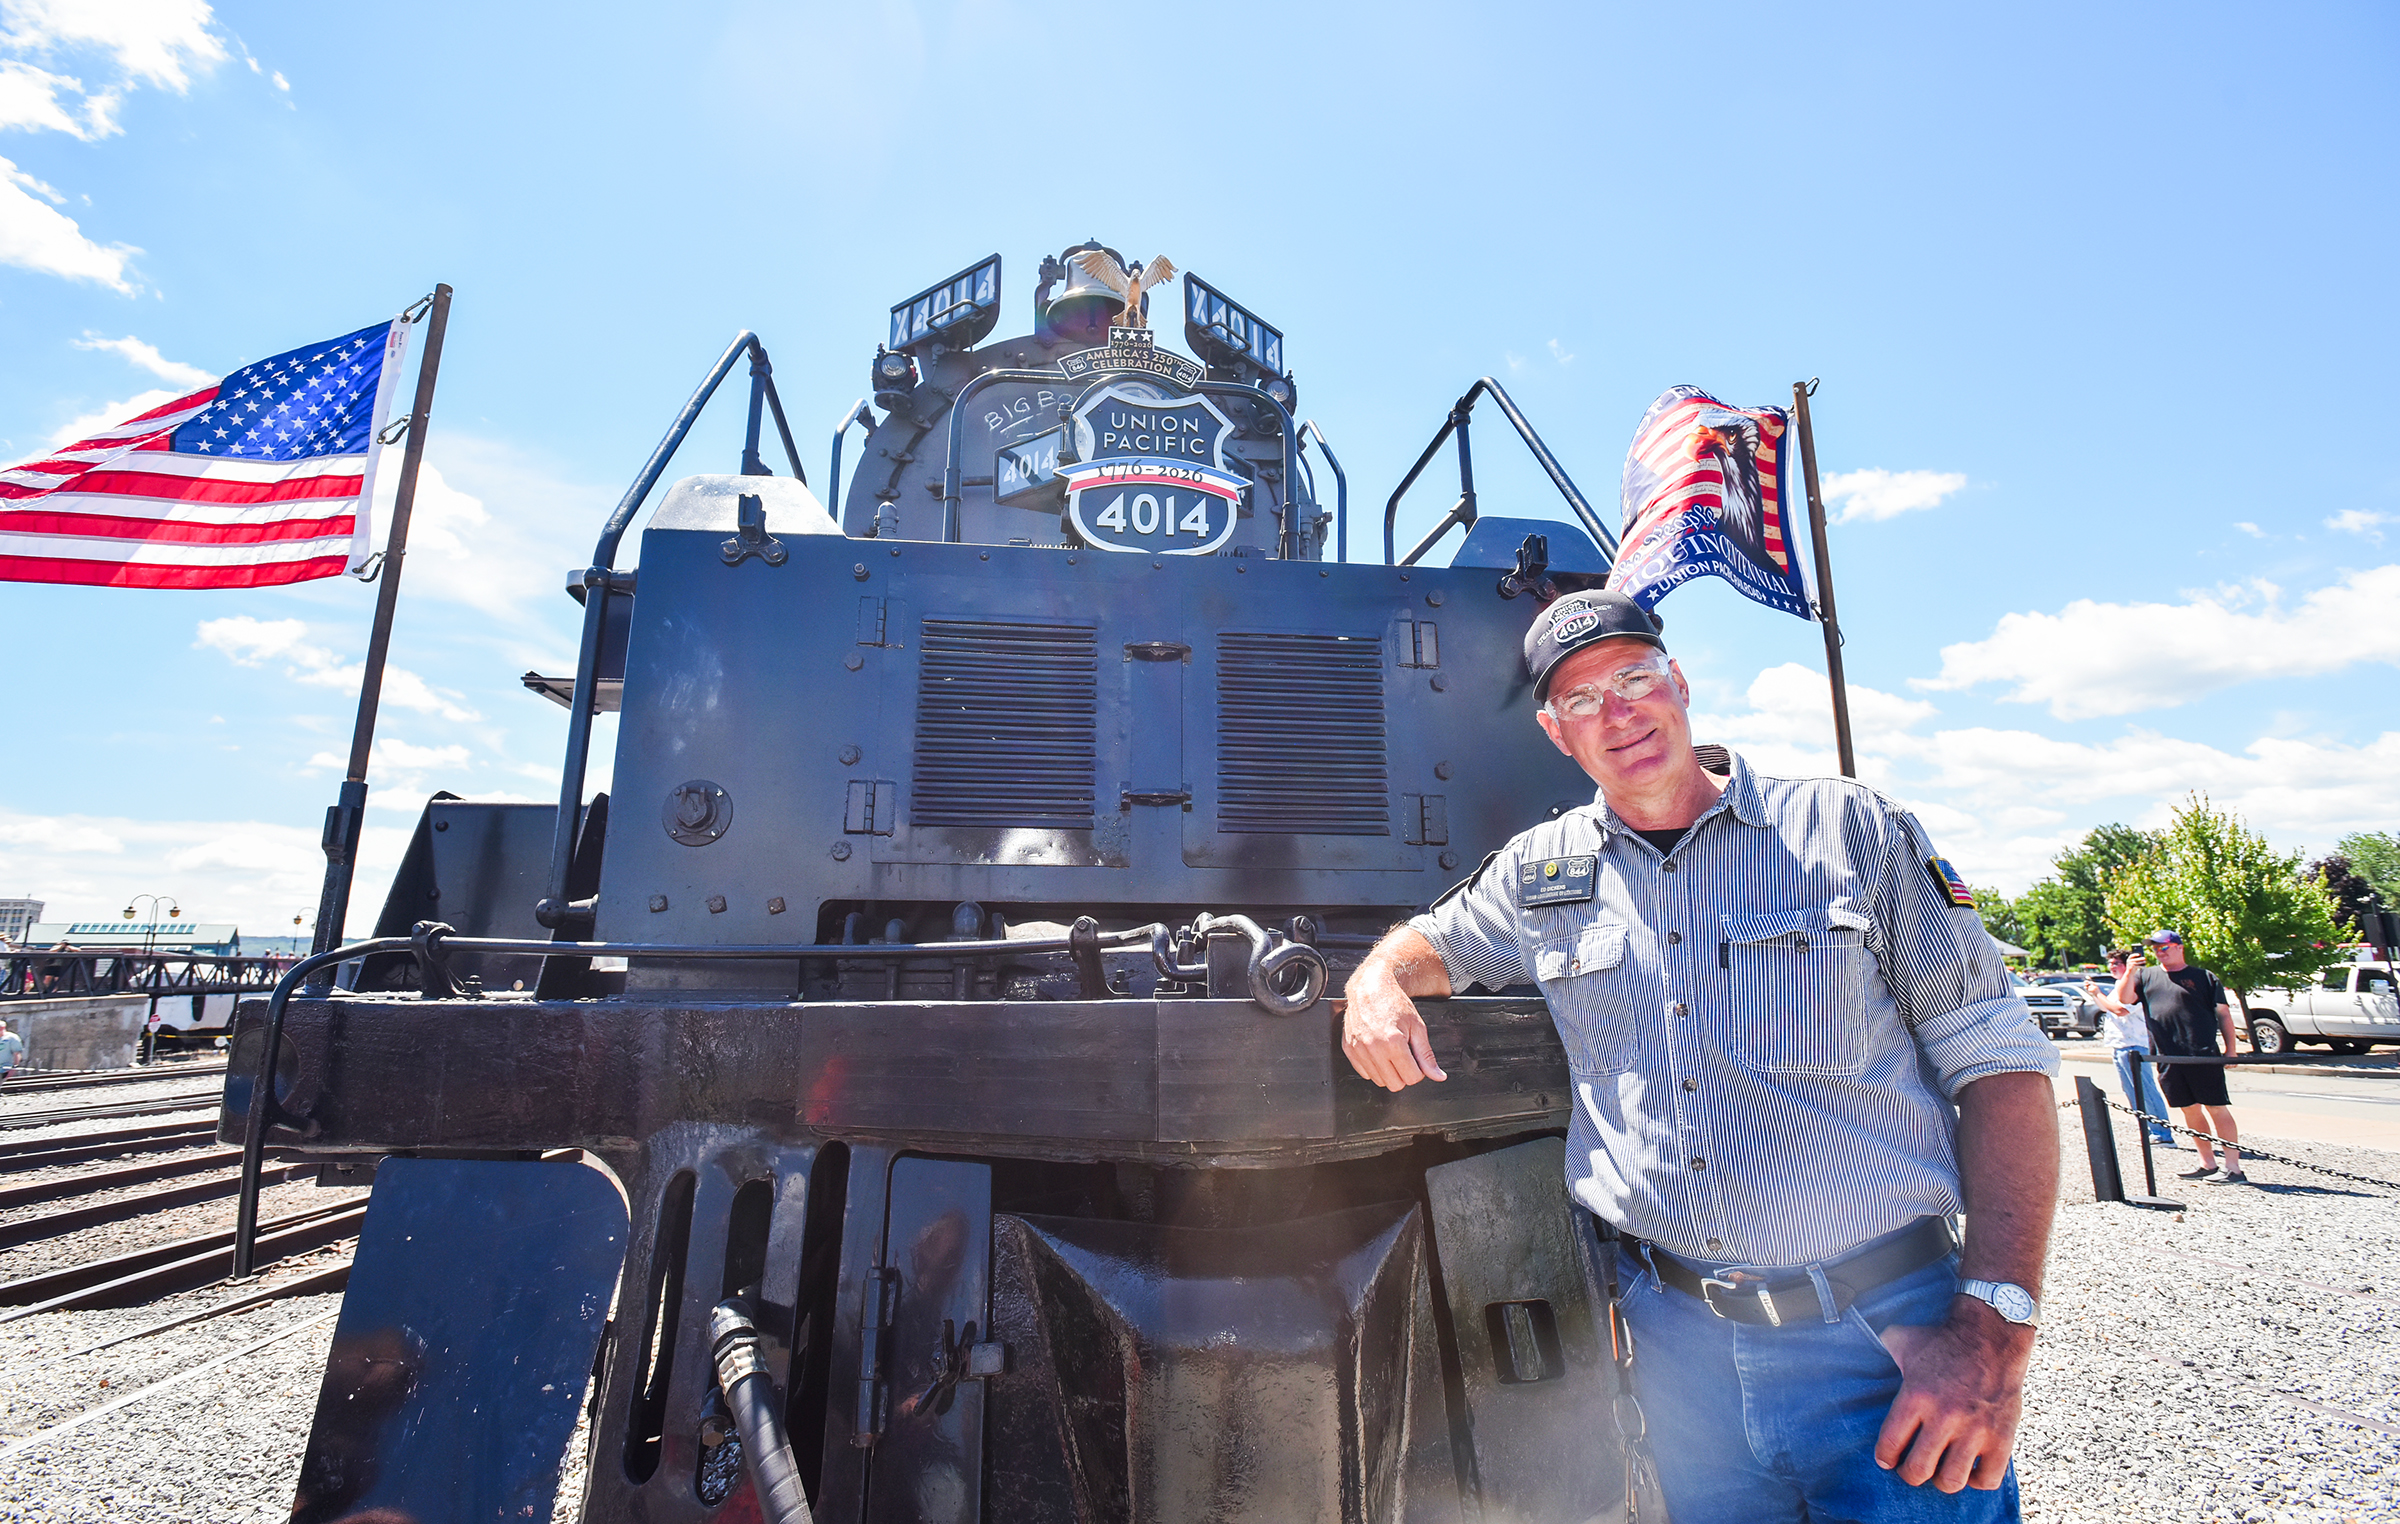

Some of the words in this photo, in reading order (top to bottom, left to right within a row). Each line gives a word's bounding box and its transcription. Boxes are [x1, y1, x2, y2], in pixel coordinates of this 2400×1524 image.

[893, 262, 995, 346] X4014
[1191, 282, 1280, 372] X4014
[1086, 348, 1149, 361] AMERICA'S
[1110, 340, 1152, 348] 1776-2026
[1092, 358, 1172, 375] CELEBRATION
[984, 397, 1031, 431] BIG
[1111, 411, 1200, 433] UNION
[1103, 431, 1206, 455] PACIFIC
[1003, 445, 1055, 483] 4014
[1096, 491, 1210, 538] 4014
[1658, 560, 1711, 592] UNION
[1555, 601, 1581, 616] UNION
[1555, 604, 1585, 621] PACIFIC
[1559, 614, 1594, 638] 4014
[1570, 867, 1587, 876] 844
